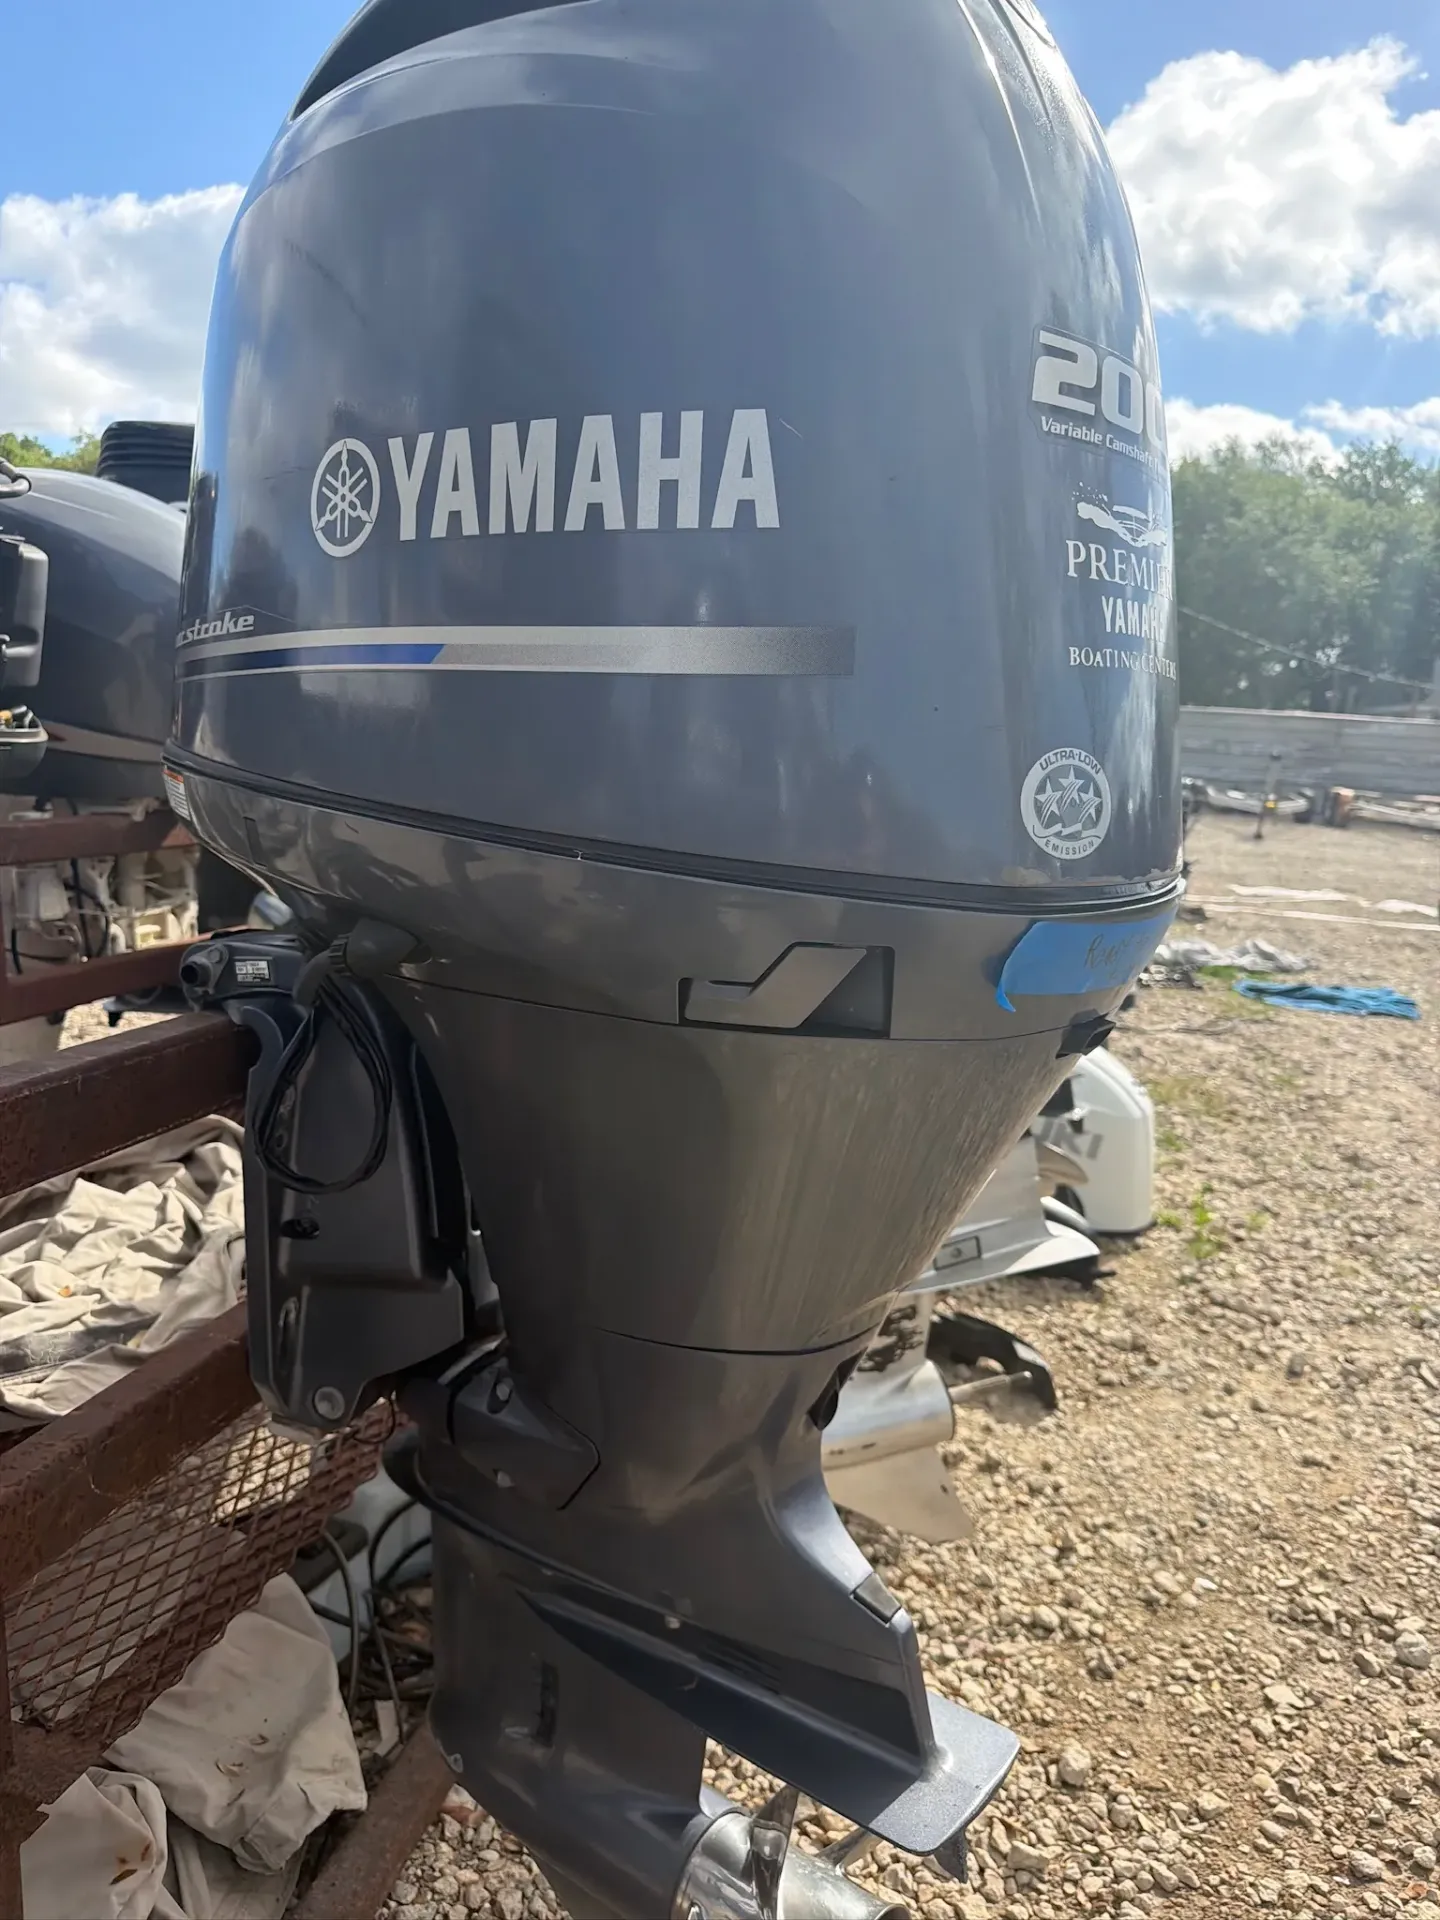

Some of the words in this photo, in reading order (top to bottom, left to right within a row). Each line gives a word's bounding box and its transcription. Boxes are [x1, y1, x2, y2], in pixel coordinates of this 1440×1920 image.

[1041, 416, 1103, 445] Variable
[388, 409, 780, 541] YAMAHA
[1066, 540, 1173, 600] PREMIER
[1069, 646, 1139, 671] BOATING
[1044, 839, 1095, 856] EMISSION
